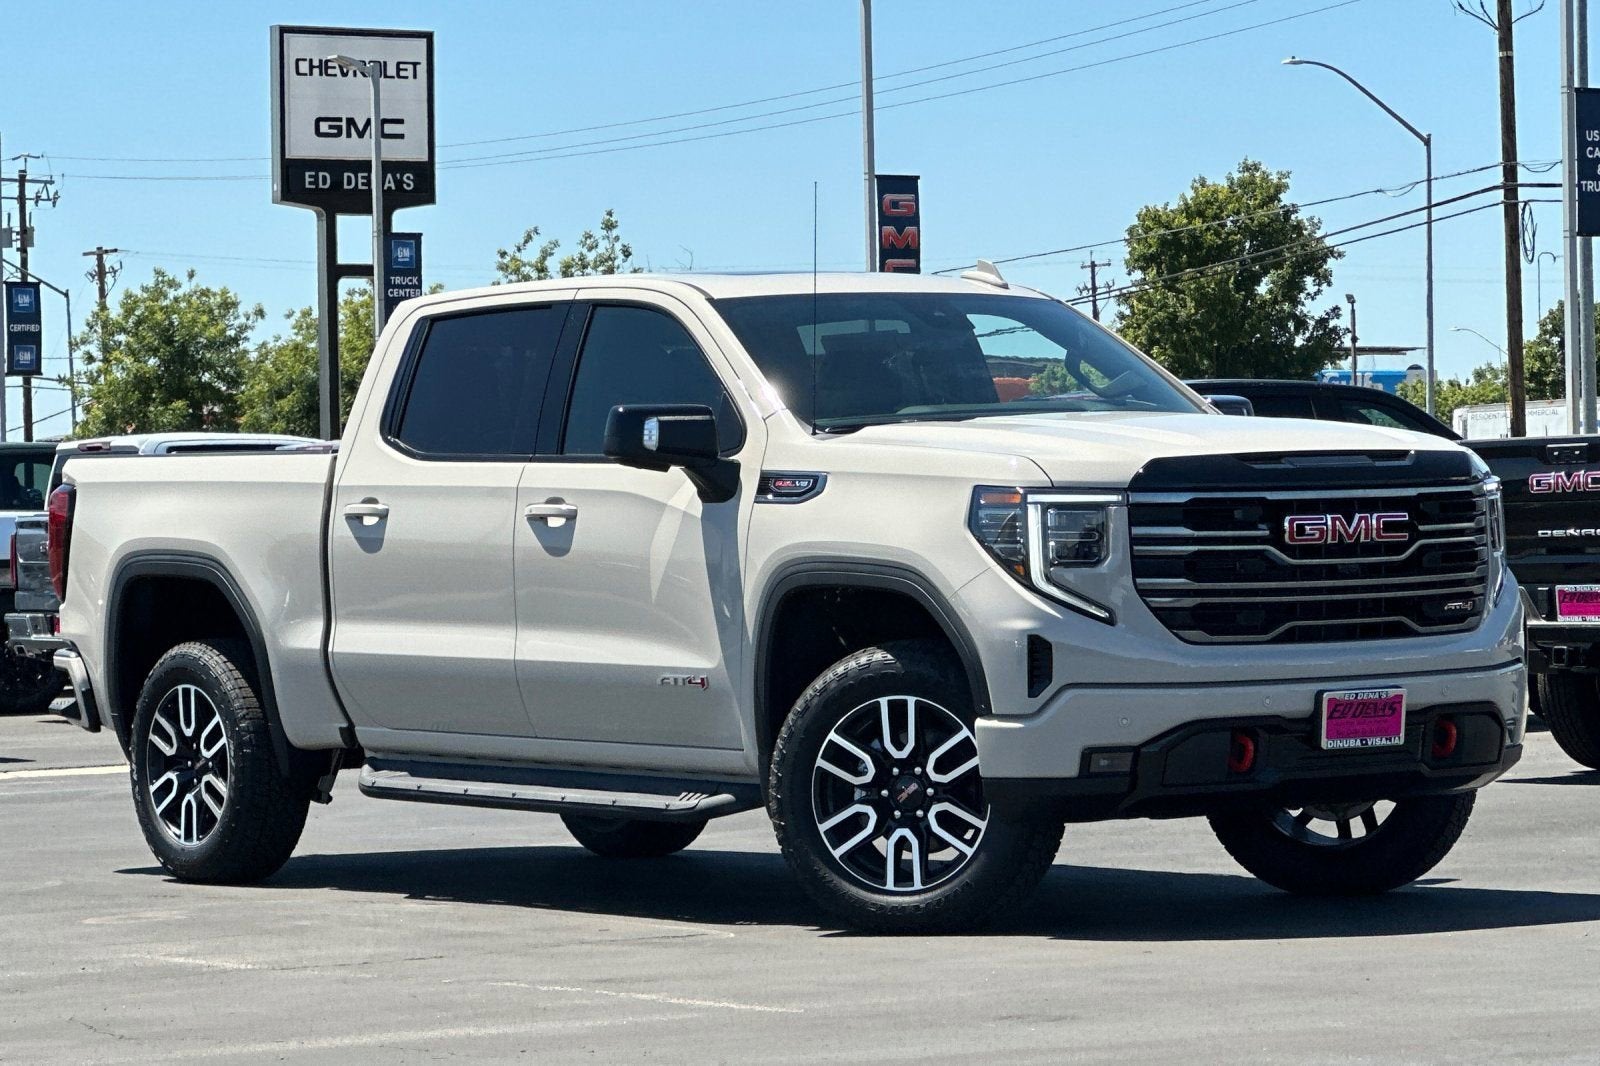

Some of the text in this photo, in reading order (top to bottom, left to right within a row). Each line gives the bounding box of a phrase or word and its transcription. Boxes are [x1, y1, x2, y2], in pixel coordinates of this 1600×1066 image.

[314, 116, 405, 139] GMC
[304, 171, 414, 190] ED DEA'S
[397, 246, 410, 258] GM
[389, 276, 419, 286] TRUCK
[18, 294, 30, 304] GM
[387, 288, 421, 298] CENTER
[9, 323, 40, 332] CERTIFIED
[19, 351, 31, 361] GM
[1529, 470, 1600, 493] GMC
[1284, 512, 1409, 544] GMC
[1444, 601, 1473, 610] AT4
[657, 674, 708, 689] AT4
[1327, 736, 1401, 748] DINUBA VISALIA
